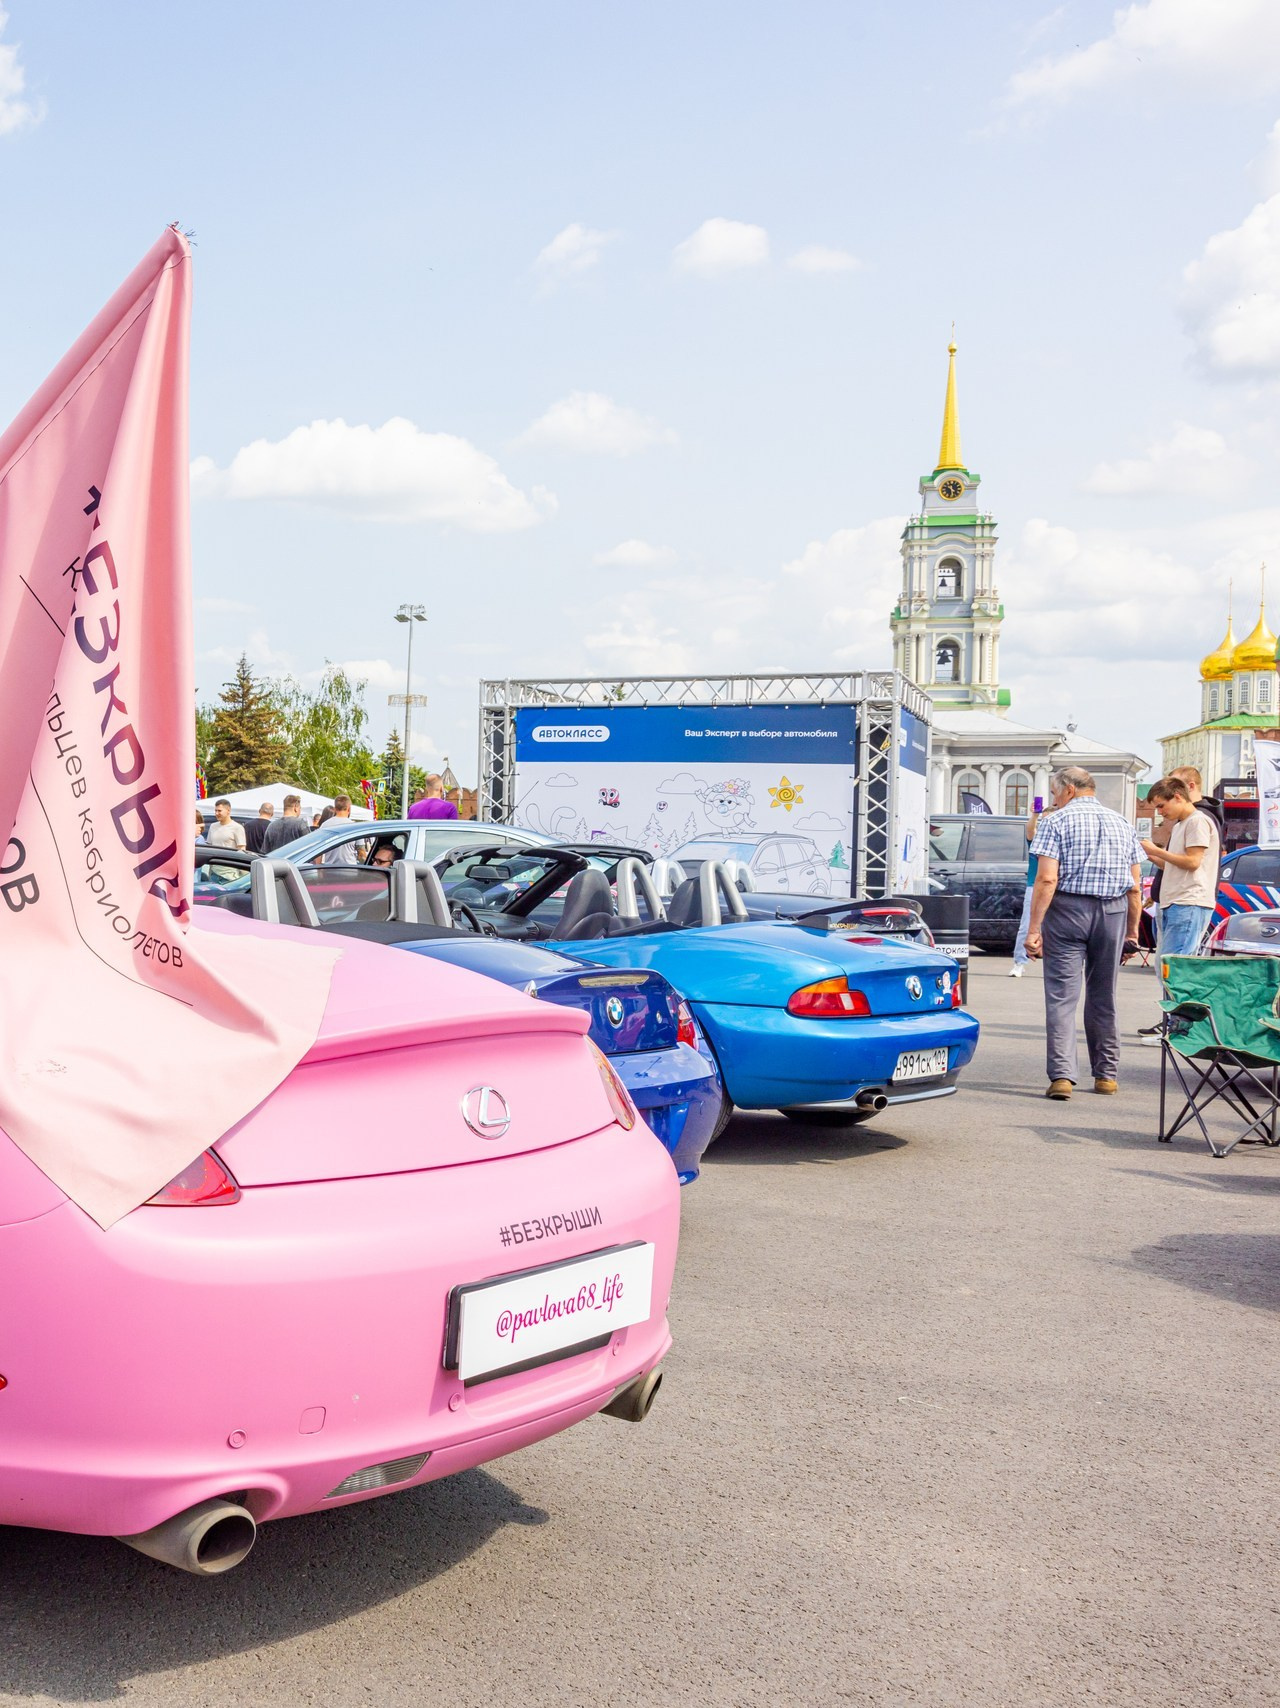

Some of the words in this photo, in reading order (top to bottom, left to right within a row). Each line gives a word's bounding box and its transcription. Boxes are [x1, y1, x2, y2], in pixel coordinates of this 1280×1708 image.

[538, 729, 603, 738] АВТОКЛАСС
[684, 729, 703, 737] Ваш
[704, 729, 740, 739] Эксперт
[749, 729, 782, 739] выборе
[784, 729, 838, 738] автомобиля
[78, 808, 183, 968] кабриолетов
[933, 1049, 946, 1065] 102
[499, 1206, 603, 1247] #БЕЗКРЫШИ
[496, 1273, 625, 1343] @pavlova68_life
